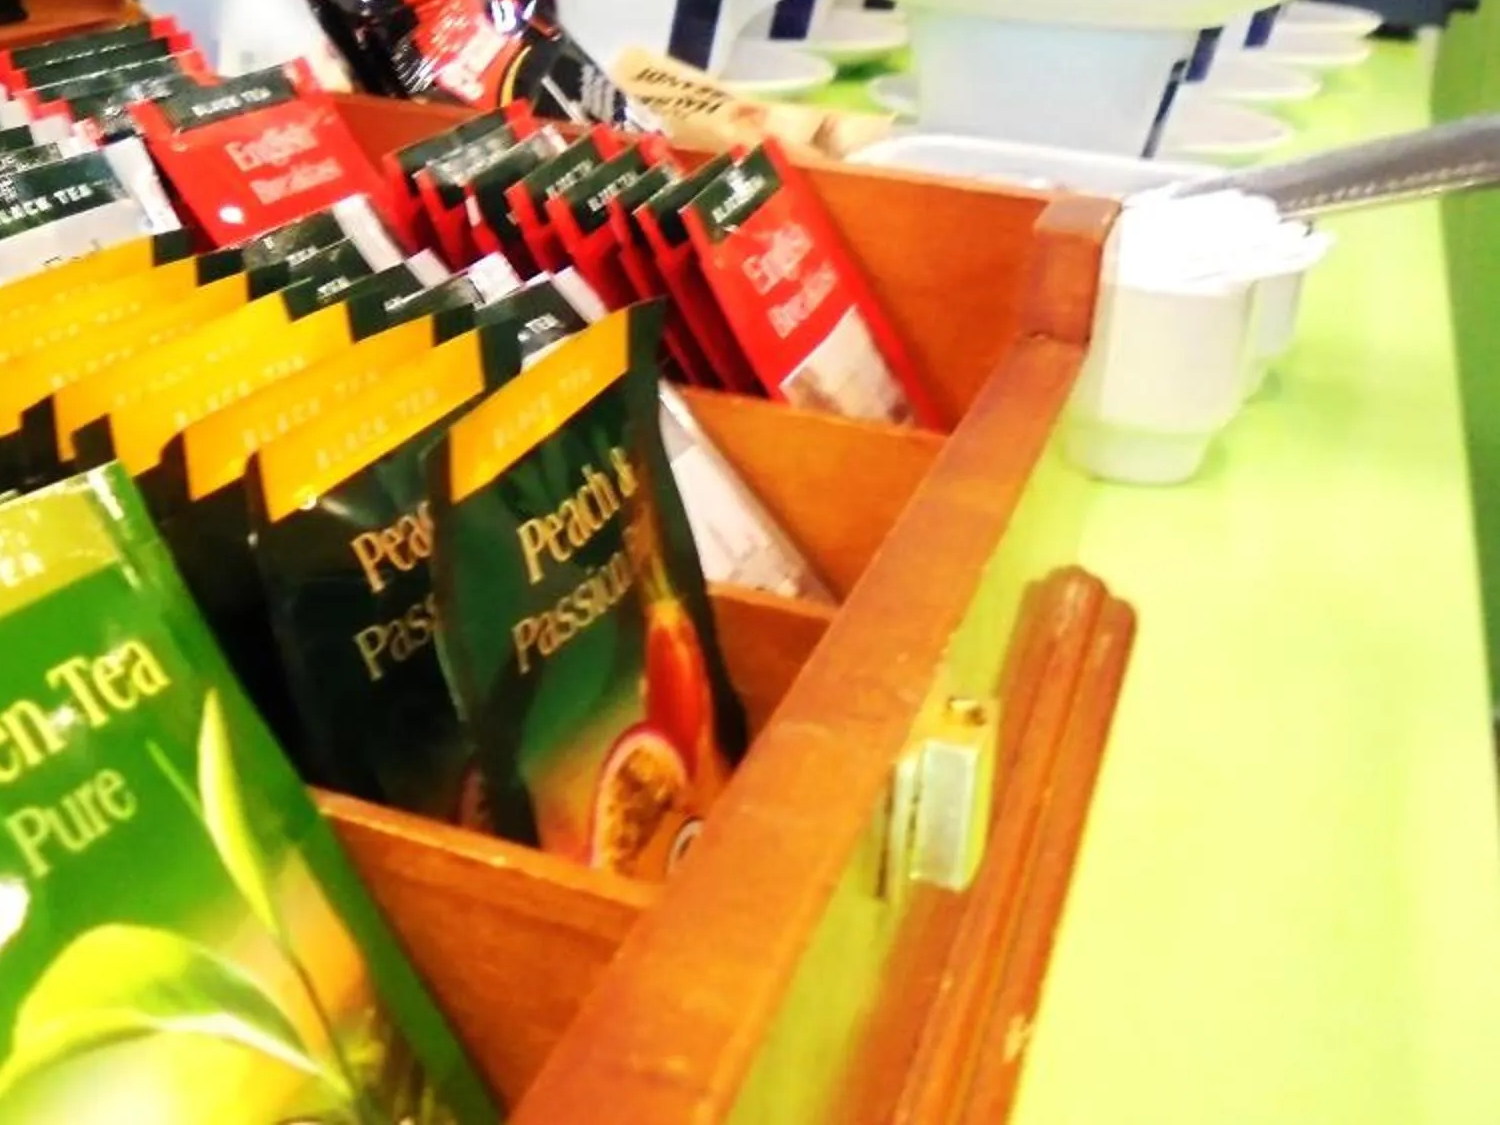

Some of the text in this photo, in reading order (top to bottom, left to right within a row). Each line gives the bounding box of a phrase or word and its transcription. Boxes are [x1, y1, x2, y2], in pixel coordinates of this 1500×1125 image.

[52, 183, 94, 205] TEA
[516, 463, 621, 585] Peach
[45, 639, 171, 729] Tea
[4, 769, 138, 879] Pure
